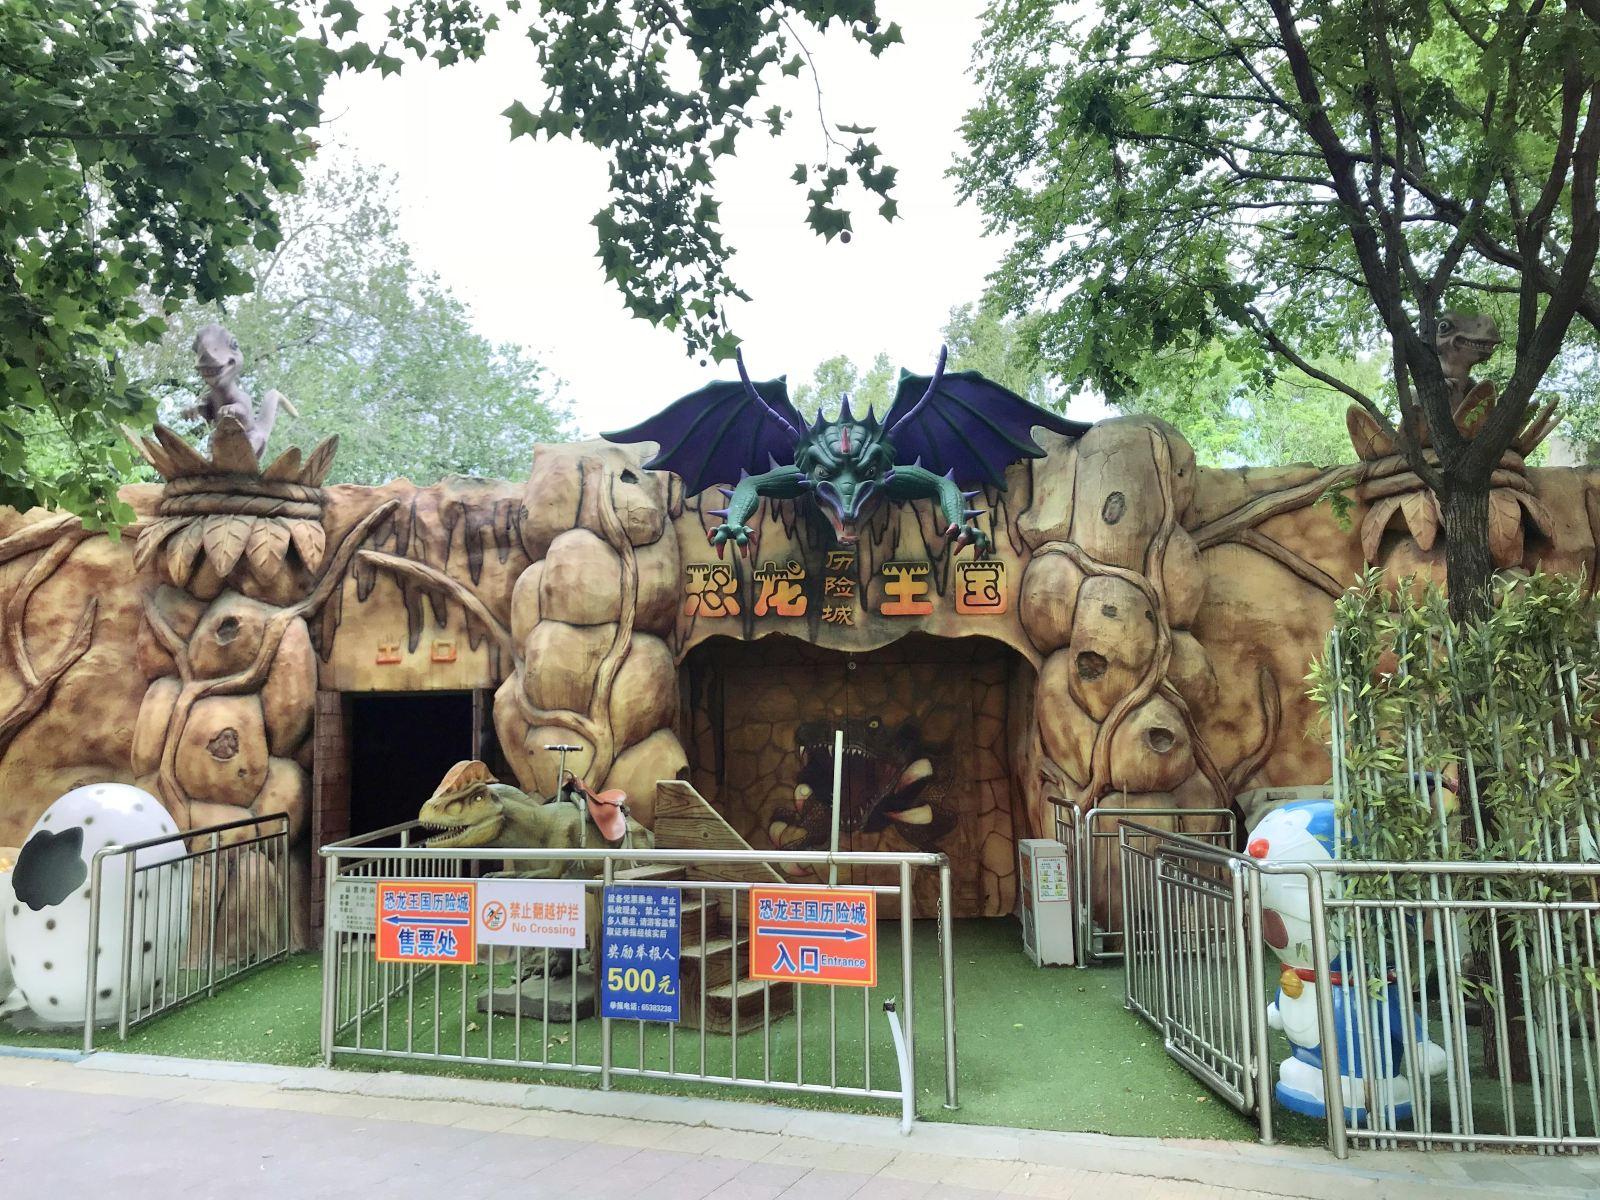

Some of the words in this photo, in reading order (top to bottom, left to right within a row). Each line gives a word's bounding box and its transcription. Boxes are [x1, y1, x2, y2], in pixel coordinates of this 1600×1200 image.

[821, 550, 857, 627] 历险城
[376, 635, 457, 664] 出口
[383, 891, 470, 913] 恐龙王国历险城
[759, 898, 868, 925] 恐龙王国历险城
[397, 927, 458, 957] 售票处
[512, 923, 527, 933] No
[530, 924, 576, 937] Crossing
[607, 942, 676, 961] 奖励举报人
[772, 941, 820, 973] 入口
[821, 953, 866, 968] Entrance
